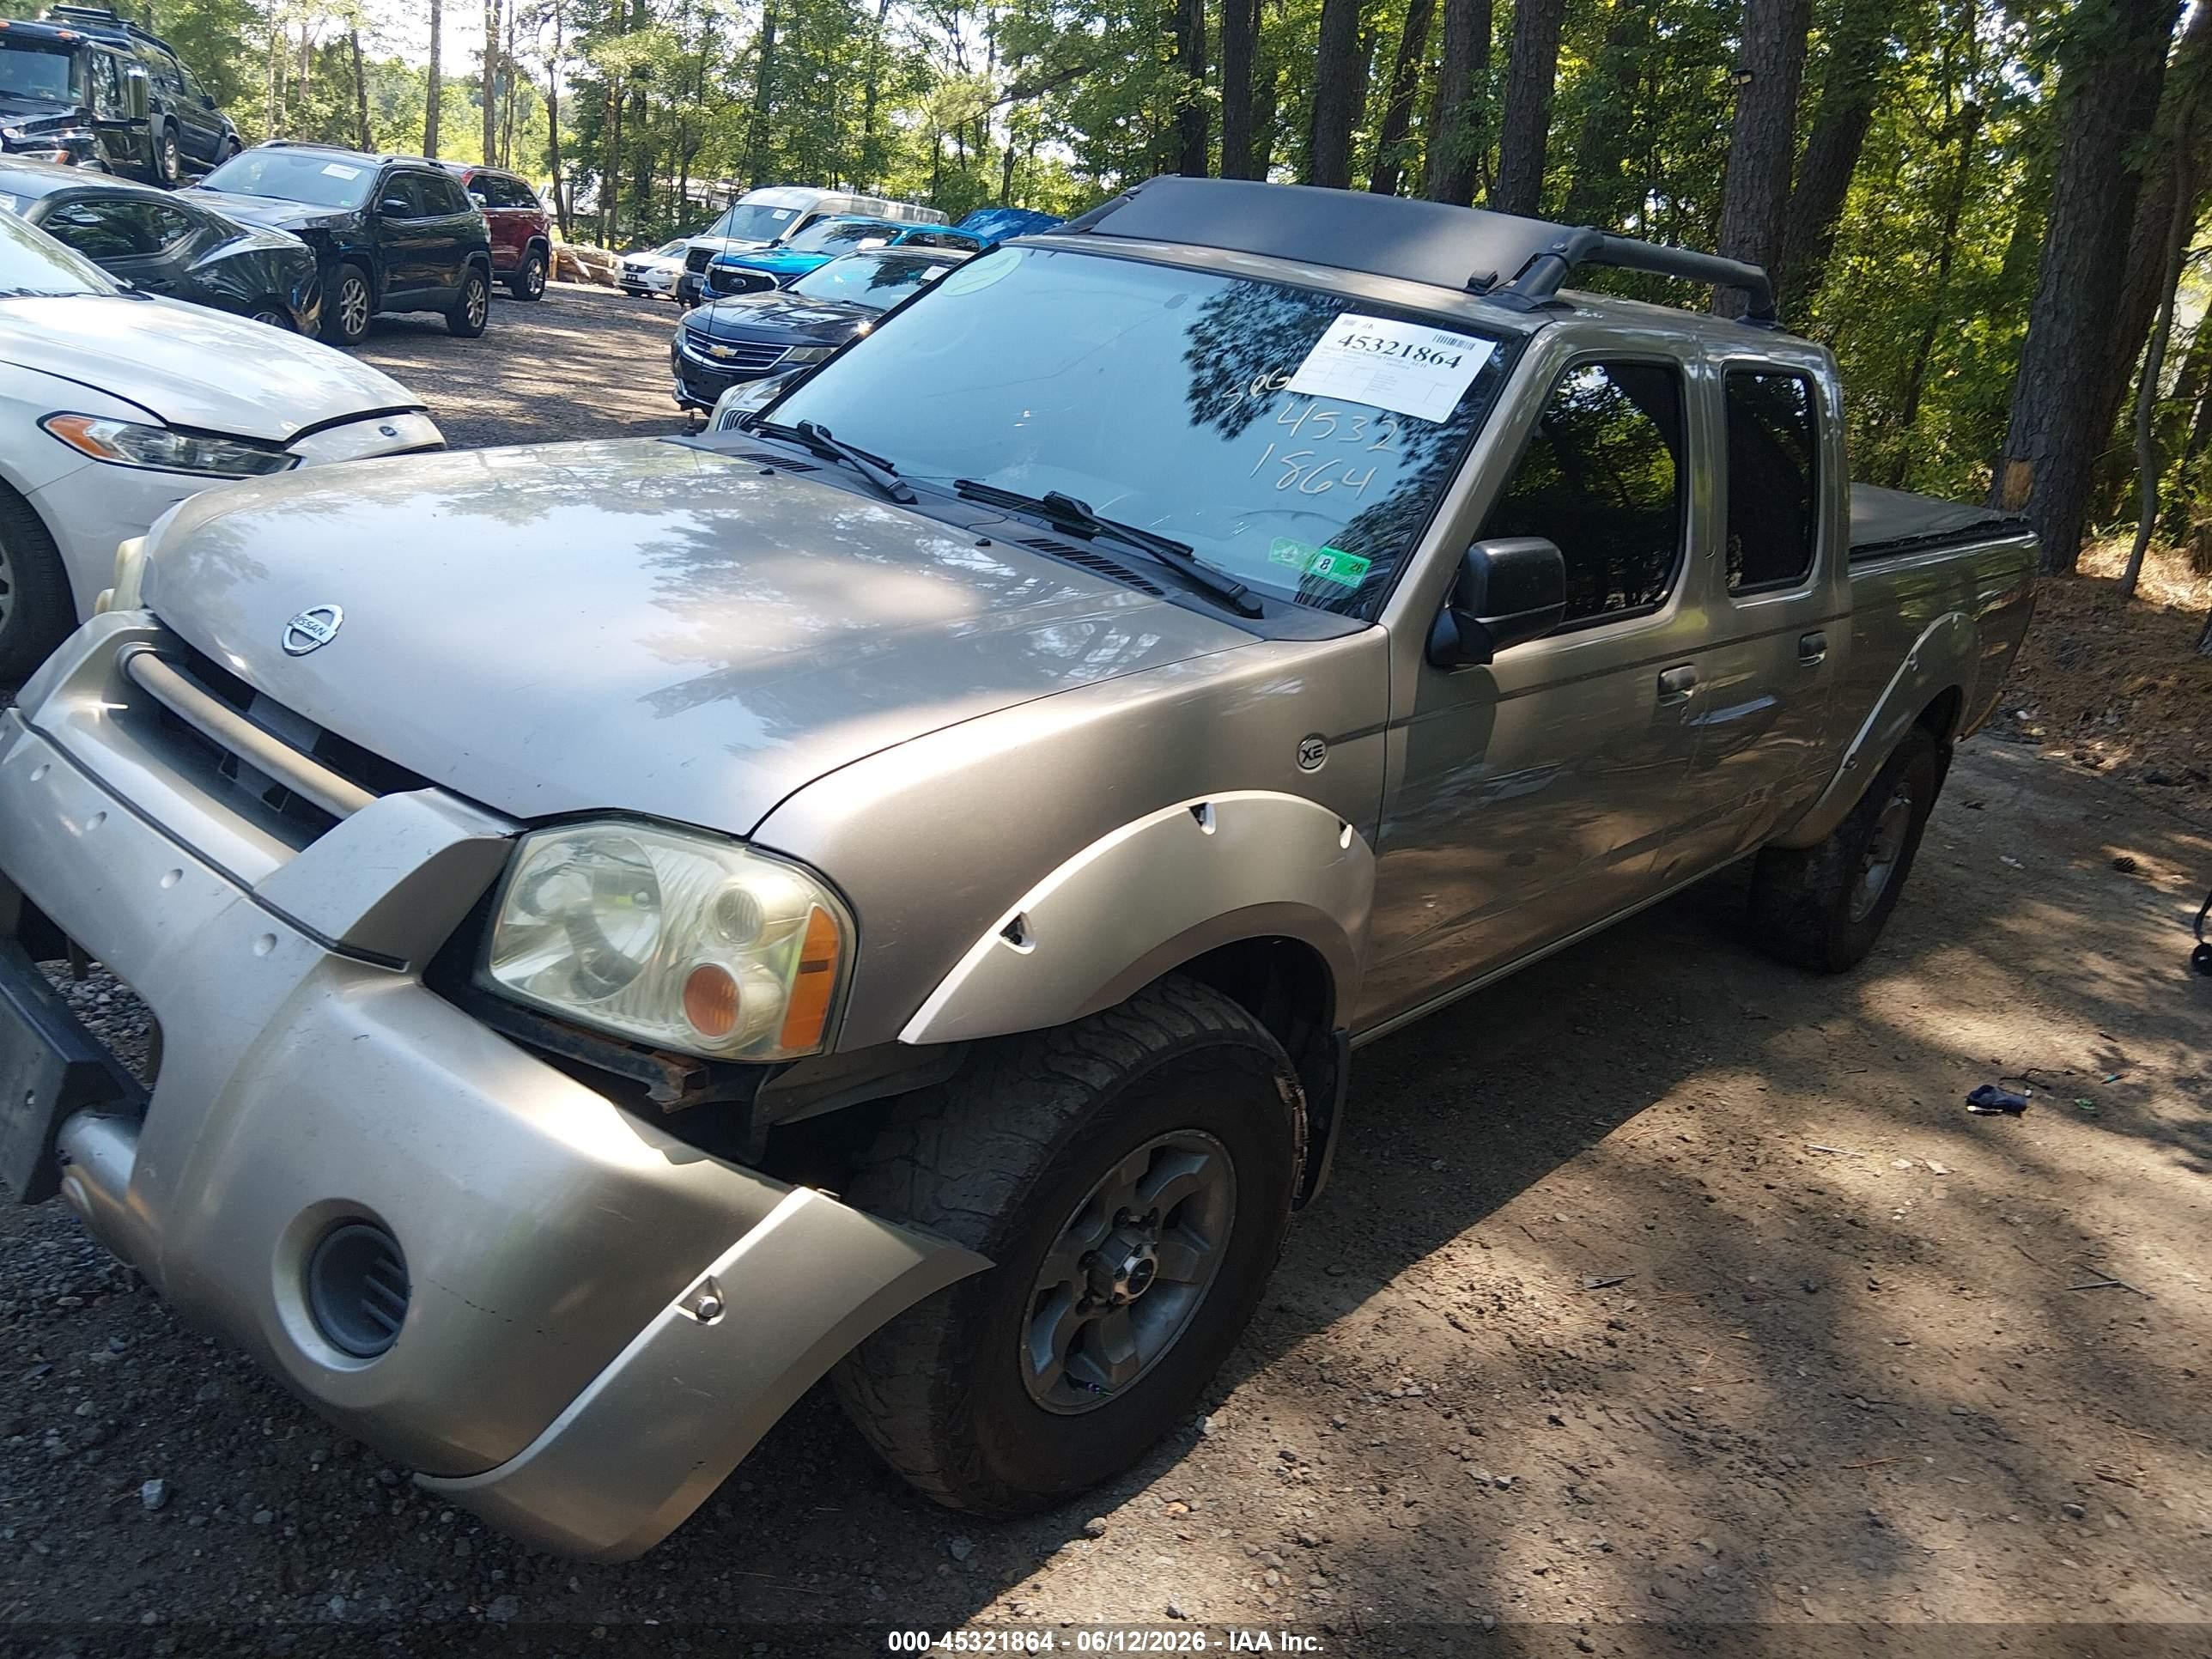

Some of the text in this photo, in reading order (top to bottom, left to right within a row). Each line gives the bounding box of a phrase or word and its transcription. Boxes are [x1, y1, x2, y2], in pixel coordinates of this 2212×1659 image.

[1337, 333, 1462, 369] 45321864
[1277, 402, 1400, 453] 4532
[1249, 443, 1377, 500] 1864
[1319, 558, 1331, 570] 8
[1301, 744, 1324, 763] XE
